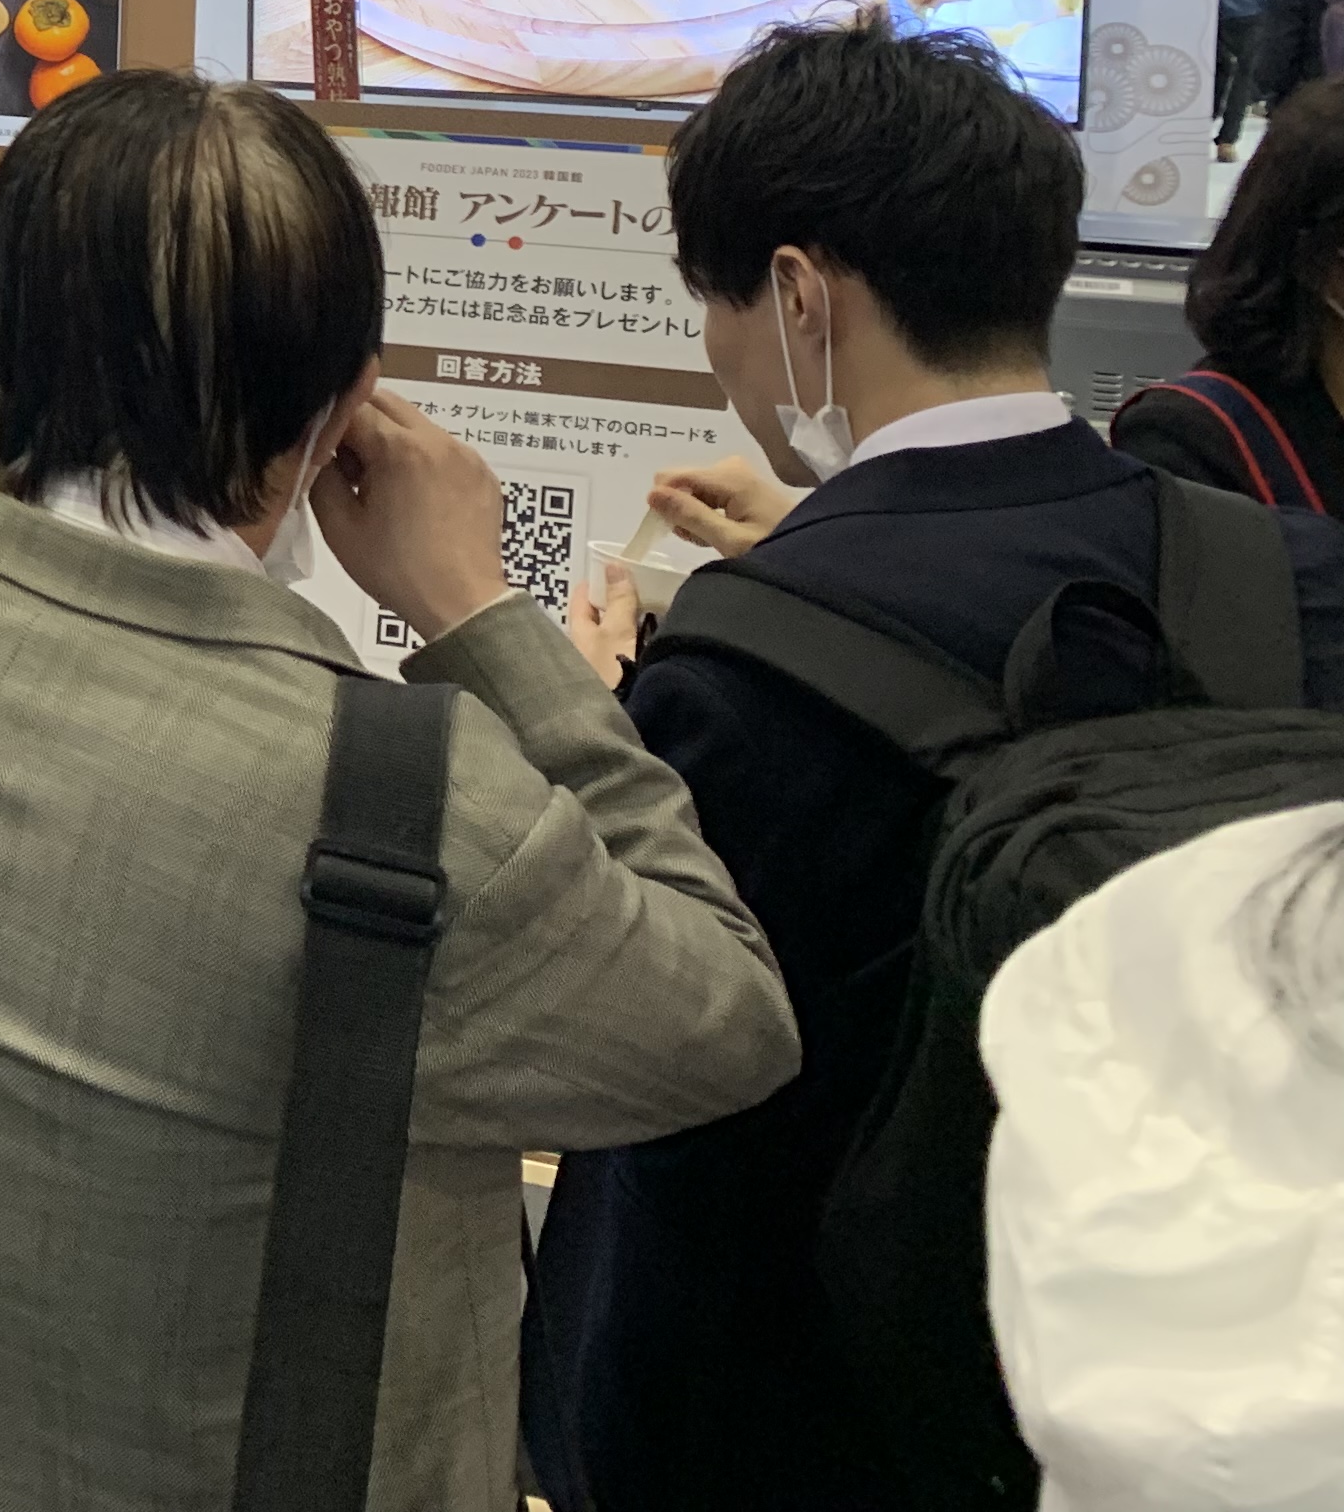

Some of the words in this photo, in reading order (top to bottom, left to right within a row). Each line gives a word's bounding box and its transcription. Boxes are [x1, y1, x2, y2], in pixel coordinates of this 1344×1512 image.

[420, 162, 466, 175] FOODEX
[470, 165, 509, 178] JAPAN
[512, 168, 539, 180] 2023
[543, 170, 583, 183] 韓国館
[459, 191, 676, 236] アンケートの
[436, 354, 543, 387] 回答方法
